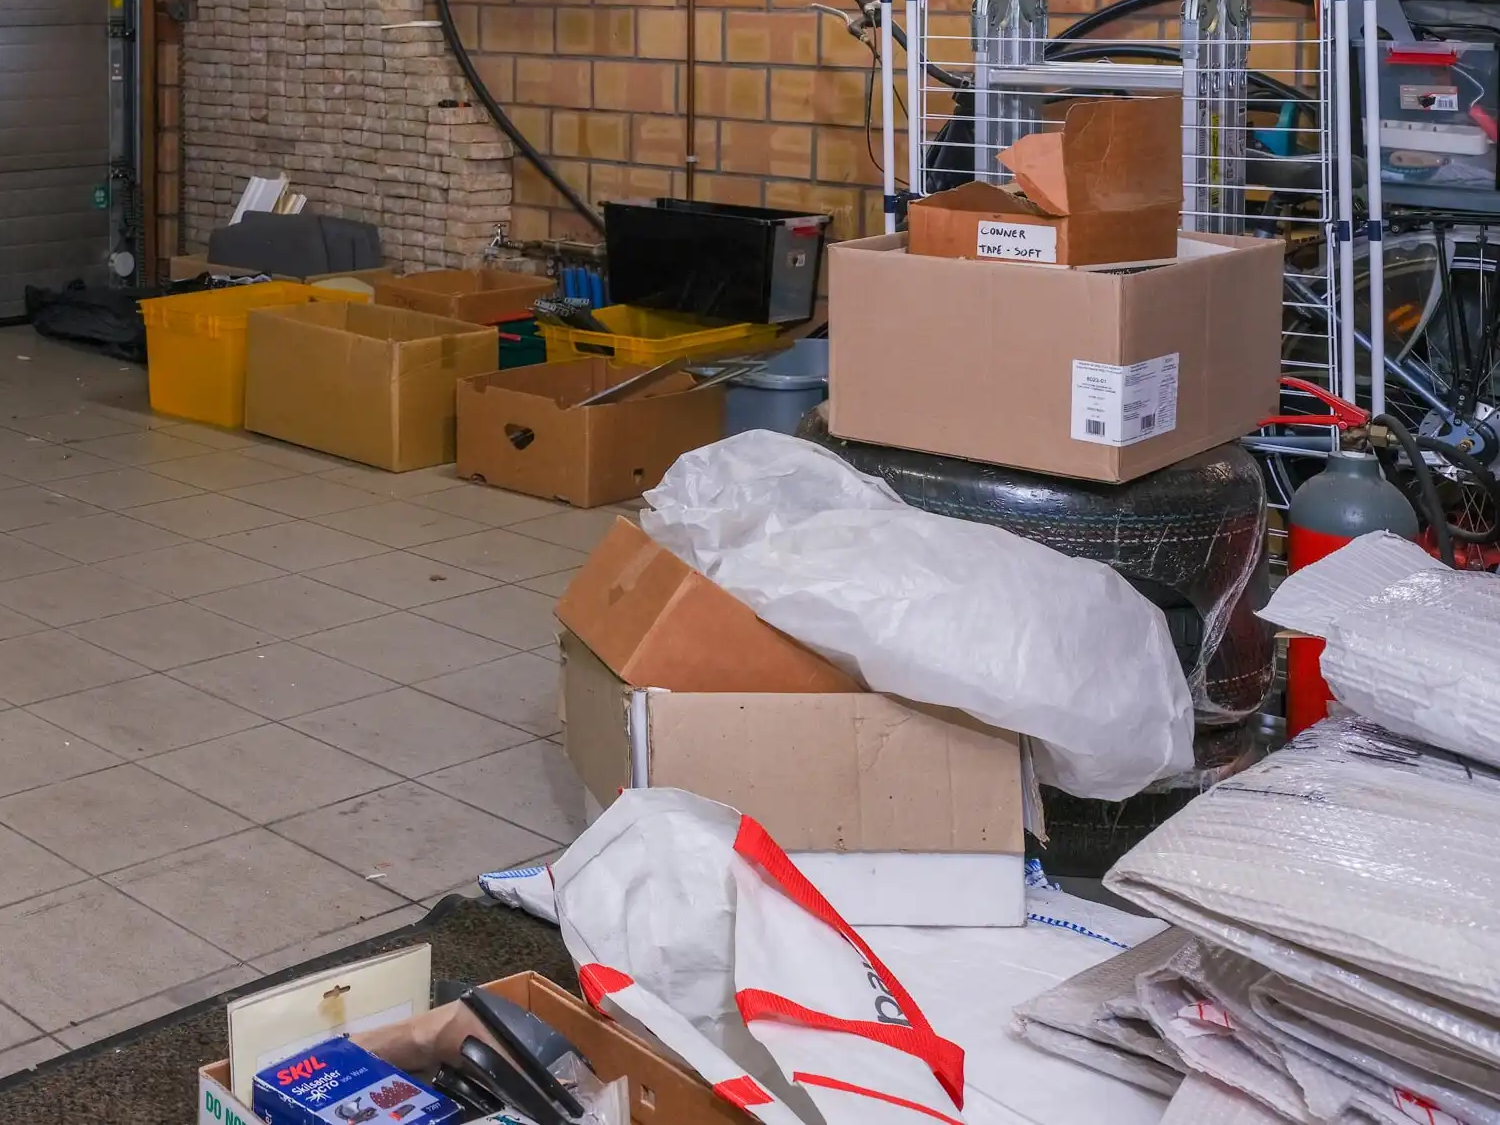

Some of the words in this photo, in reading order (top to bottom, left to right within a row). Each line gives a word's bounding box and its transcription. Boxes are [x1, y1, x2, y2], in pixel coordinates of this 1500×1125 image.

[980, 227, 1026, 239] CONNER
[978, 245, 1002, 255] TAPE
[1014, 247, 1042, 258] SOFT
[277, 1056, 328, 1086] SKIL
[291, 1069, 341, 1096] Skilsander
[310, 1079, 339, 1097] OCTO
[206, 1090, 222, 1120] DO
